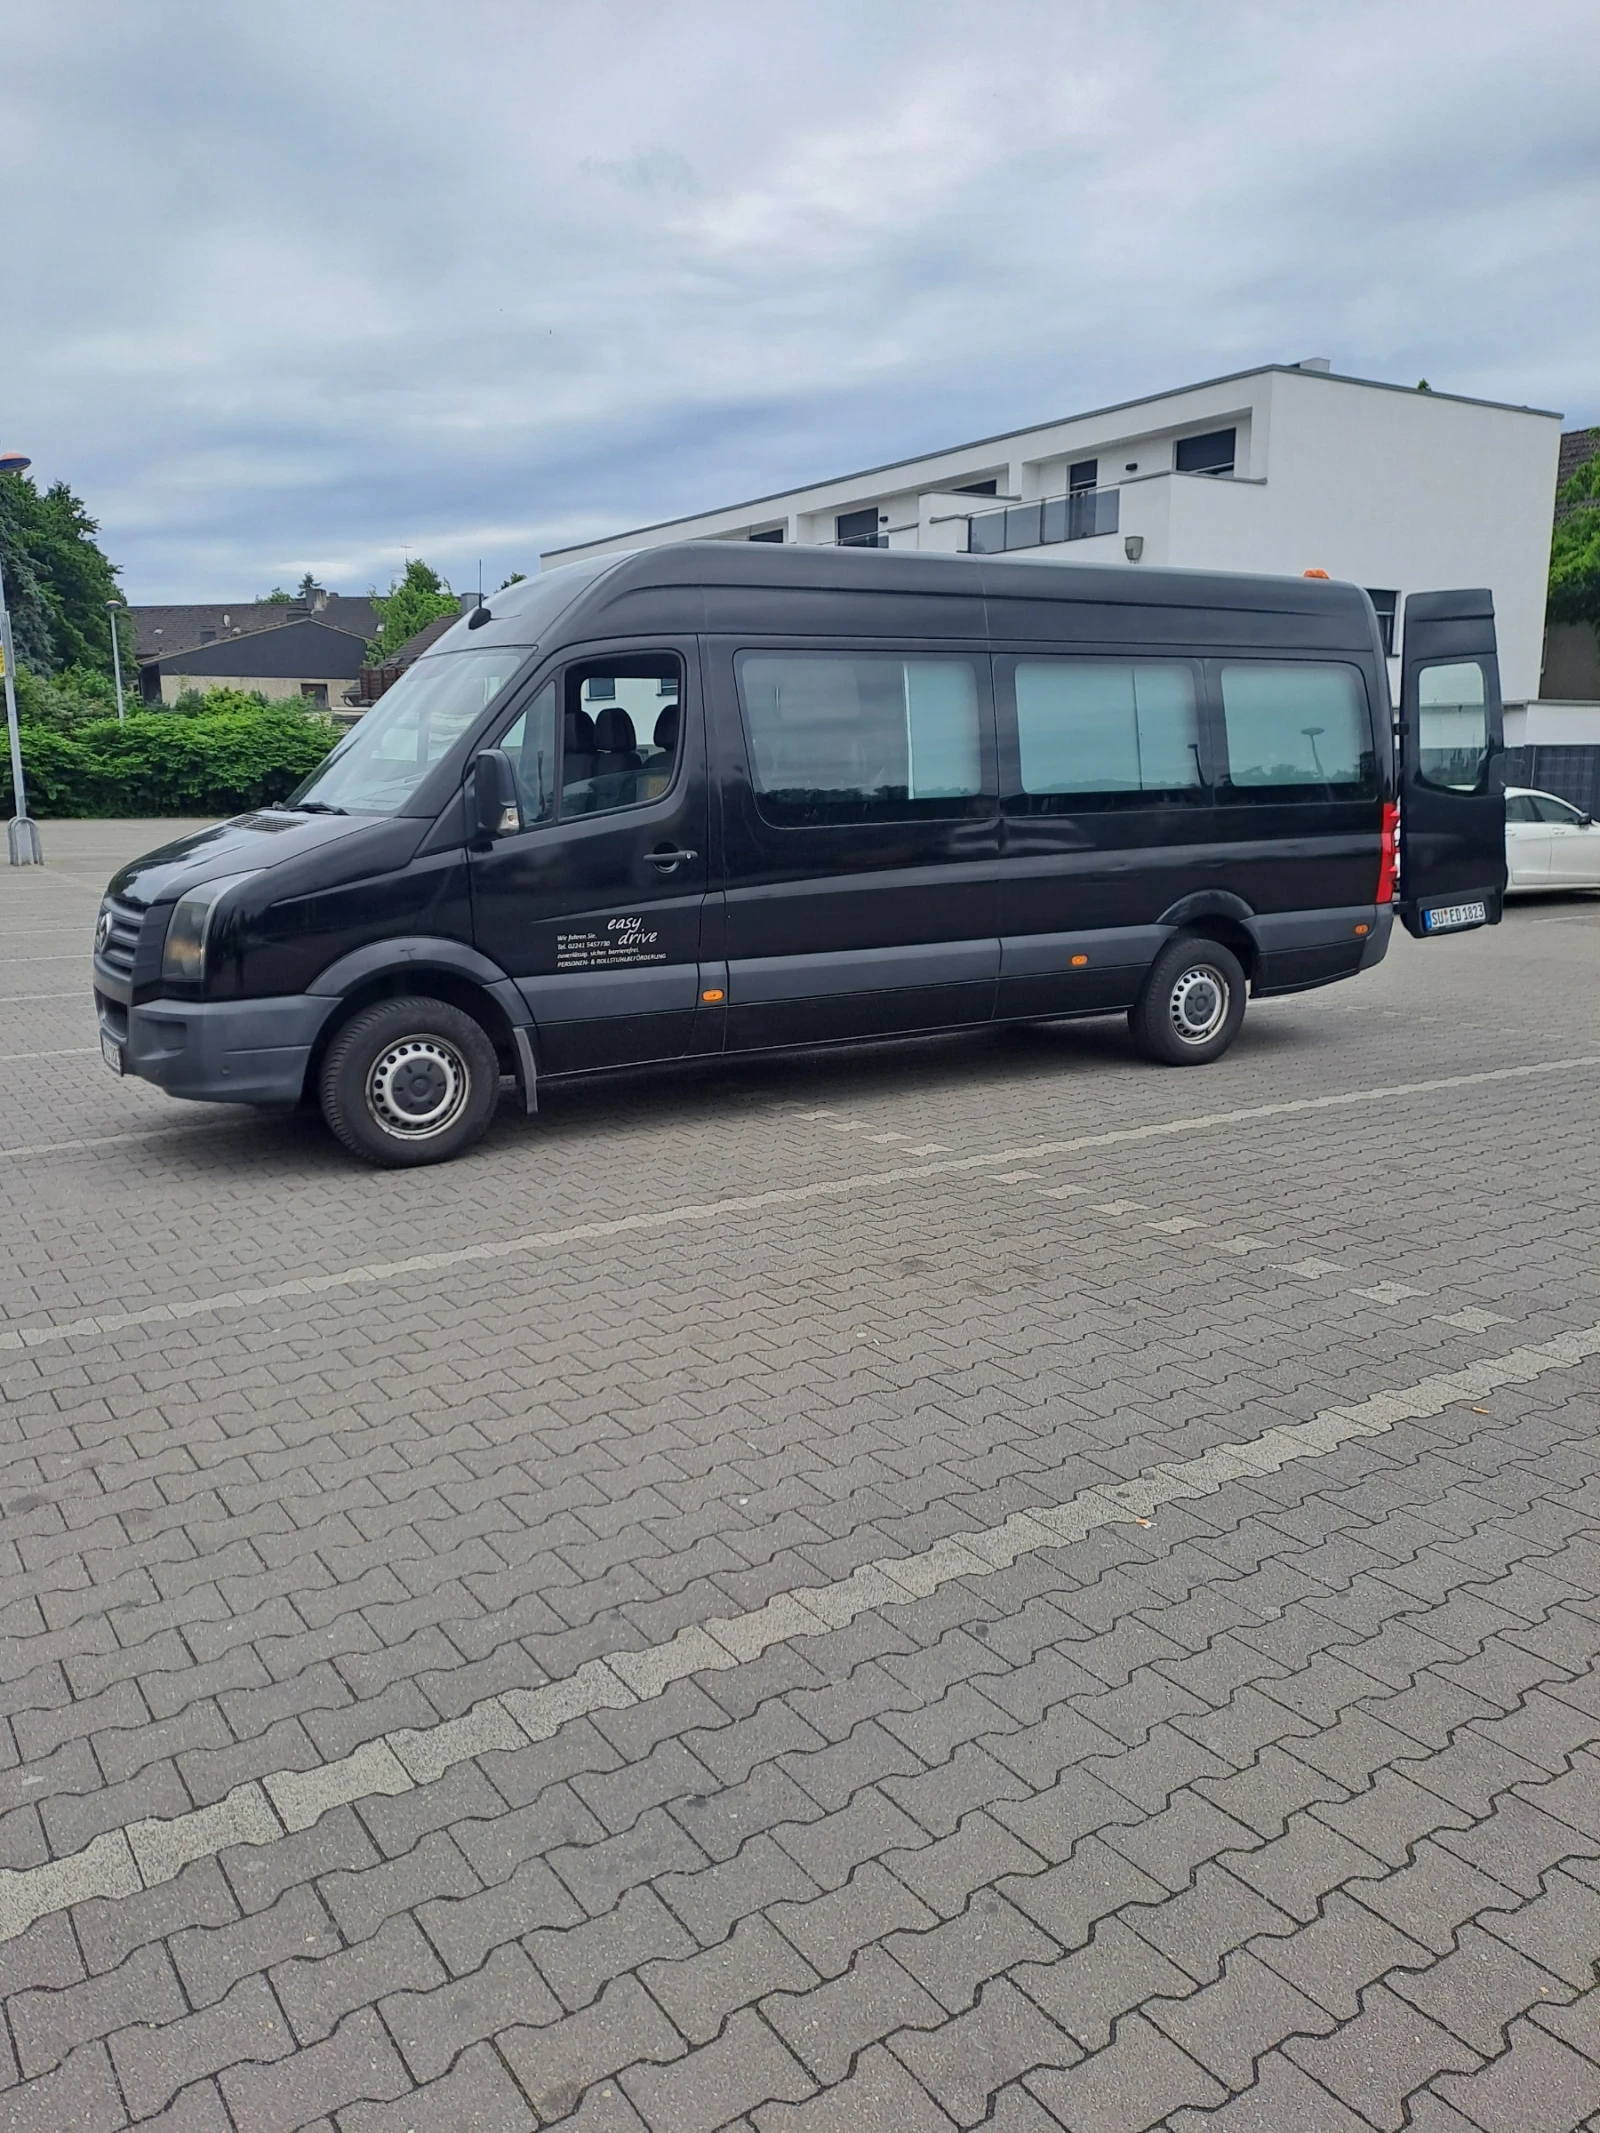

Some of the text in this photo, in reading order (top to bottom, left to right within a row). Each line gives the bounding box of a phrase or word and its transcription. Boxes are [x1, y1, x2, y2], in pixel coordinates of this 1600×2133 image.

[1431, 904, 1484, 925] SU ED 1823
[607, 917, 642, 933] easy
[618, 928, 658, 945] drive
[557, 959, 589, 968] PERSONEN-
[596, 953, 666, 964] ROLLSTUHLBEFÖRDERUNG
